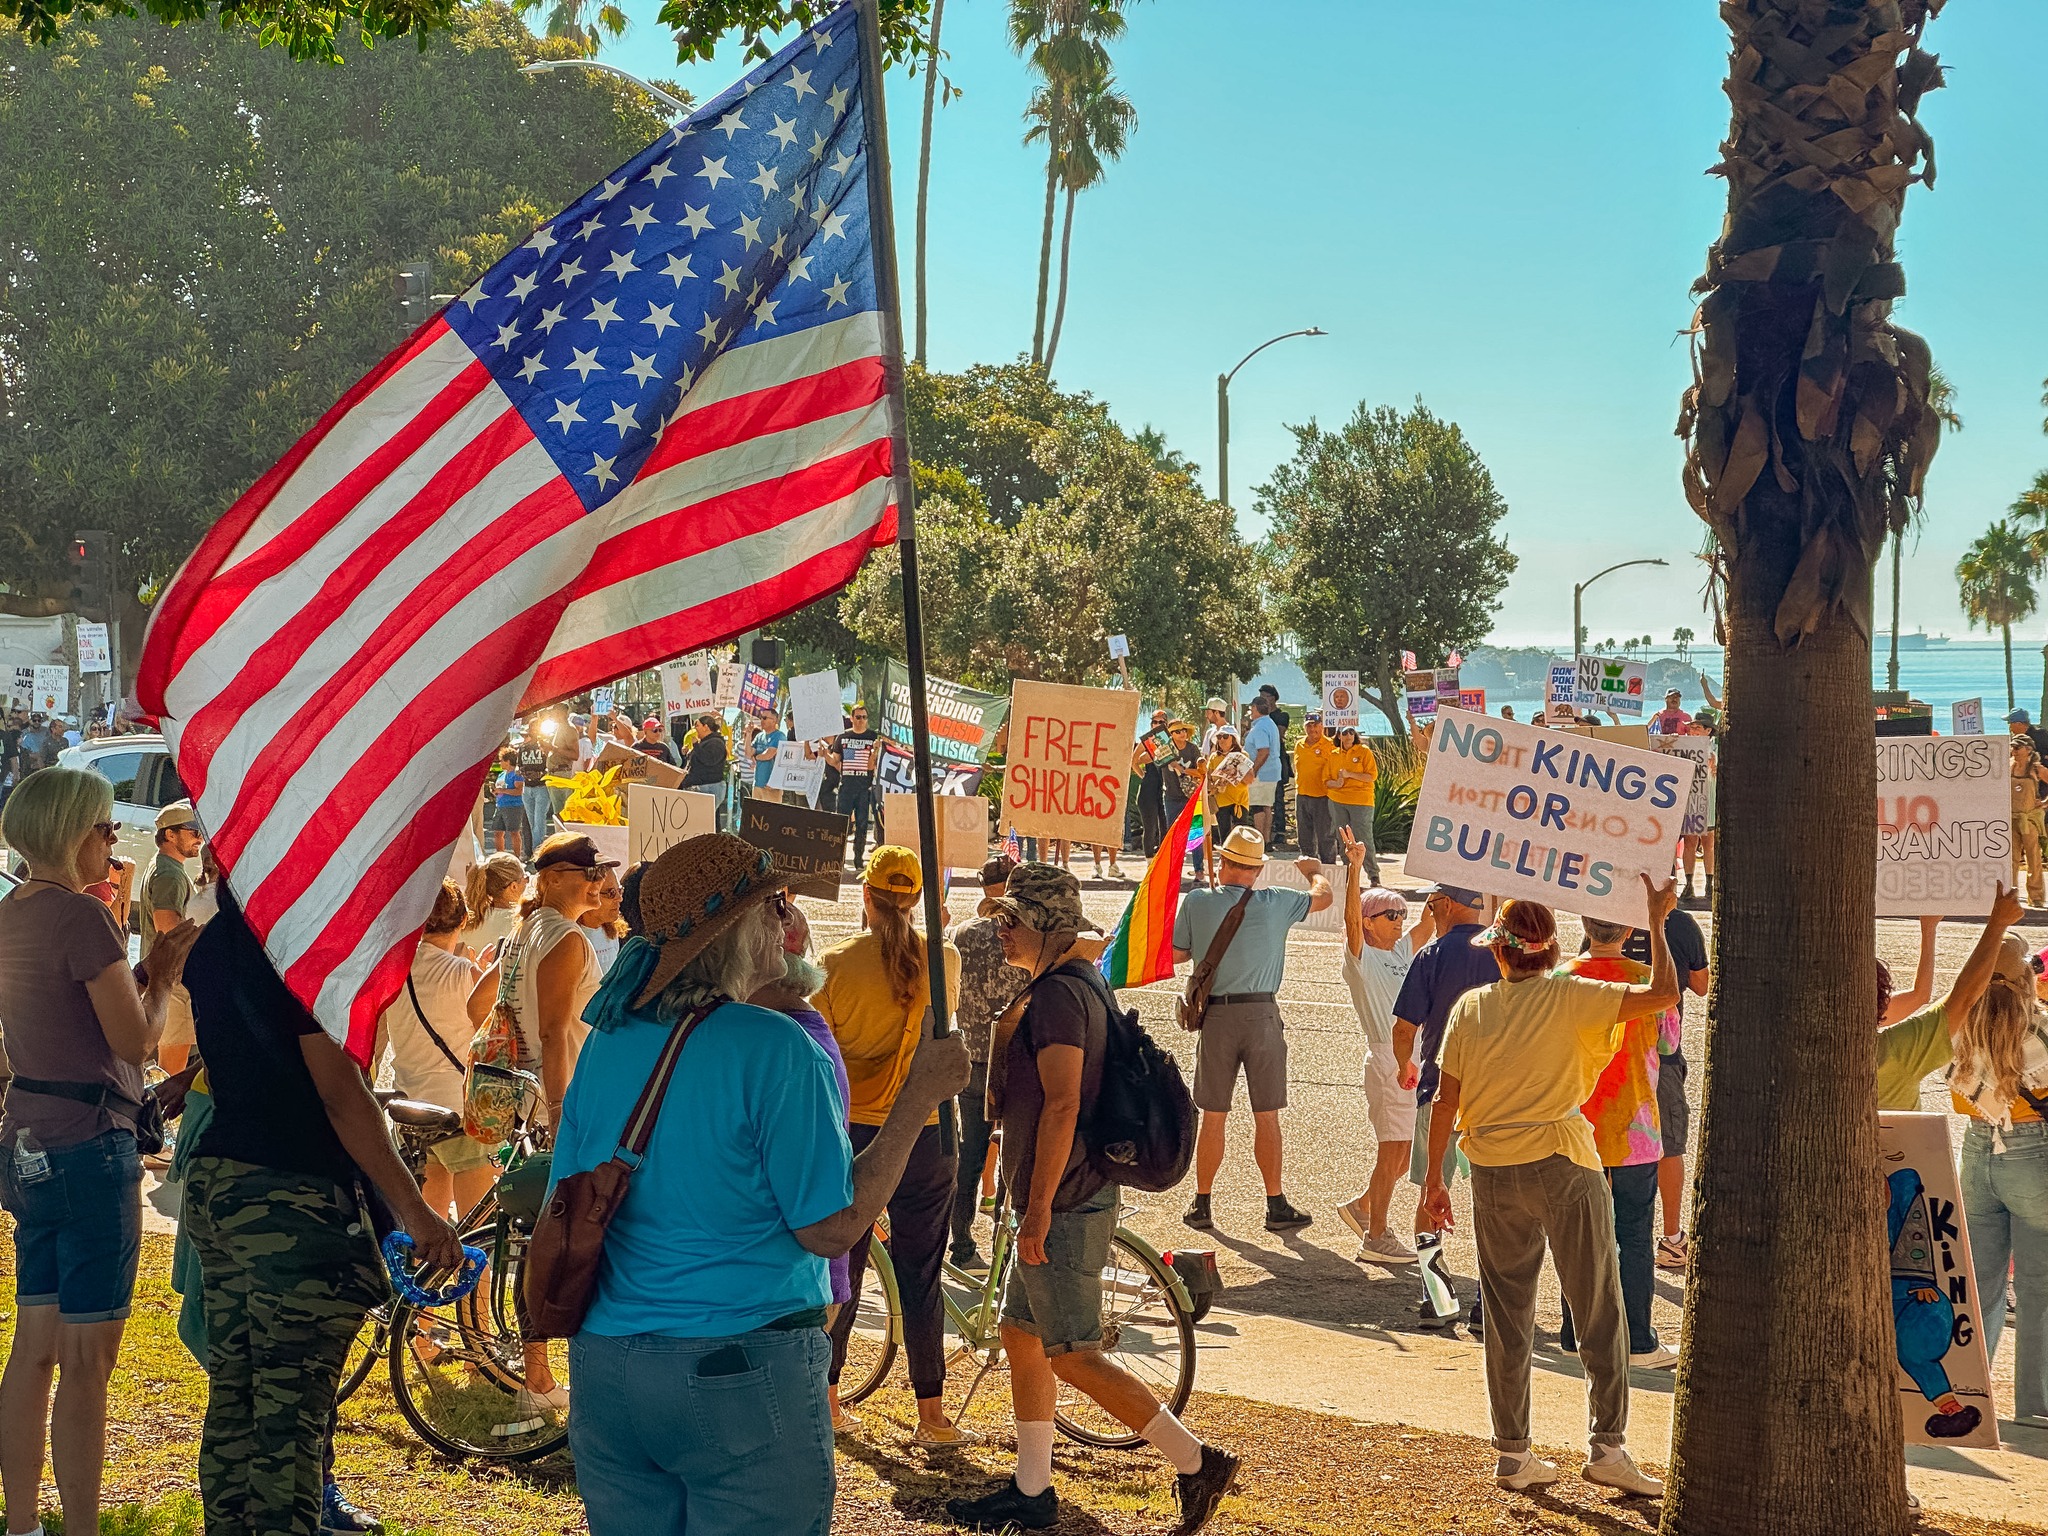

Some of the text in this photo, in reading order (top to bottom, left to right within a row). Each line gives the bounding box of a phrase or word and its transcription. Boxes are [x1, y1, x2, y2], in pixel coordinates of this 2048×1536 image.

[669, 662, 687, 670] GOTTA
[1579, 658, 1600, 677] NO
[752, 673, 768, 690] BIG
[1555, 684, 1573, 694] THE
[1577, 674, 1626, 693] NO CULTS
[685, 699, 711, 709] KINGS
[890, 682, 984, 725] PRENDING
[1574, 691, 1595, 704] JUST
[1595, 692, 1607, 705] THE
[1958, 702, 1979, 719] STOP
[928, 714, 985, 746] ACISM
[1337, 718, 1359, 727] ASSHOLE
[1960, 717, 1977, 731] THE
[881, 717, 980, 765] IS PATOTISM.
[1024, 715, 1117, 770] FREE
[1438, 718, 1680, 809] NO KINGS
[1009, 763, 1121, 820] SHRUGS
[652, 796, 689, 834] NO
[1505, 784, 1571, 831] OR
[751, 814, 769, 831] No
[781, 826, 800, 838] one
[807, 826, 815, 839] is
[1425, 815, 1615, 897] BULLIES
